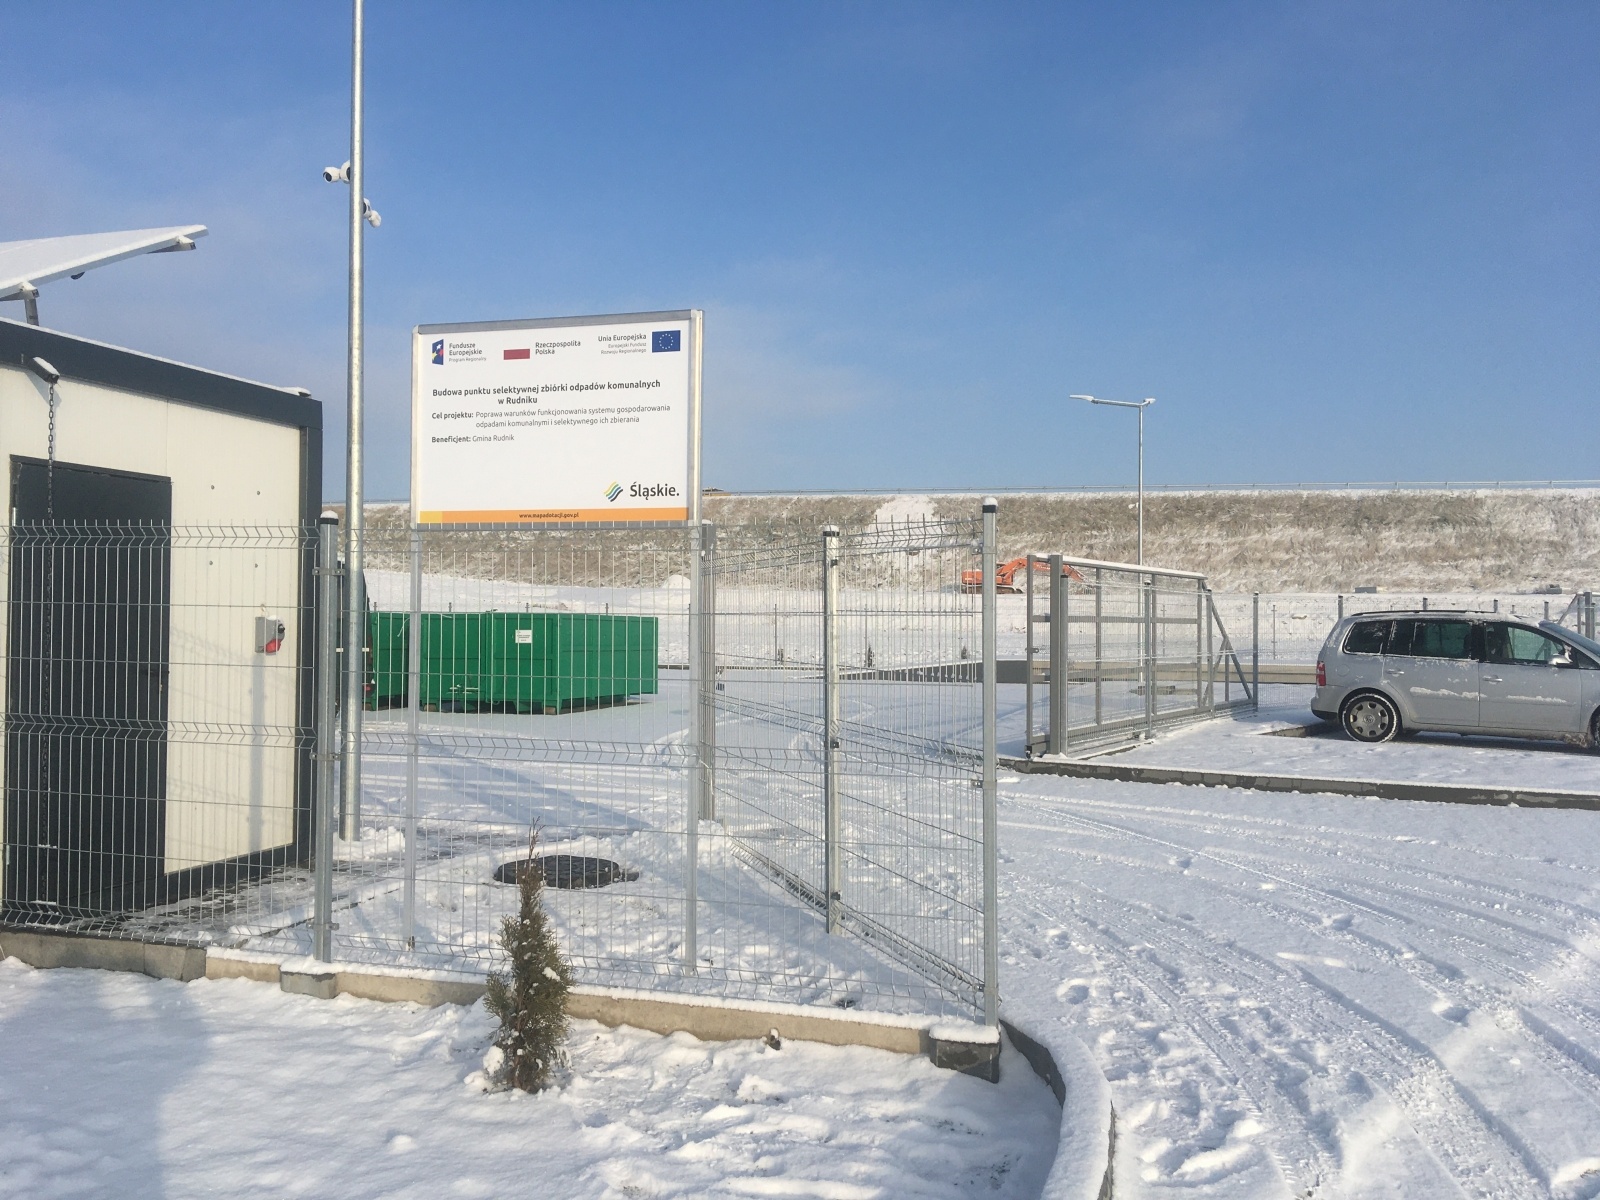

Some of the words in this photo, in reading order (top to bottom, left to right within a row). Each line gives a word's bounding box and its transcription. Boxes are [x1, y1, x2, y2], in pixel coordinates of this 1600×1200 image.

[535, 341, 580, 349] Rzeczpospolita
[433, 388, 462, 396] Budowa
[464, 387, 490, 396] punktu
[493, 385, 539, 394] selektywnej
[541, 383, 568, 393] zbiórki
[570, 382, 605, 392] odpadów
[608, 380, 660, 389] komunalnych
[506, 396, 537, 404] Rudniku
[444, 412, 473, 420] projektu:
[538, 407, 587, 417] funkcjonowania
[589, 407, 615, 415] systemu
[617, 404, 670, 414] gospodarowania
[508, 419, 549, 427] komunalnymi
[554, 418, 598, 426] selektywnego
[630, 481, 679, 500] Śląskie.
